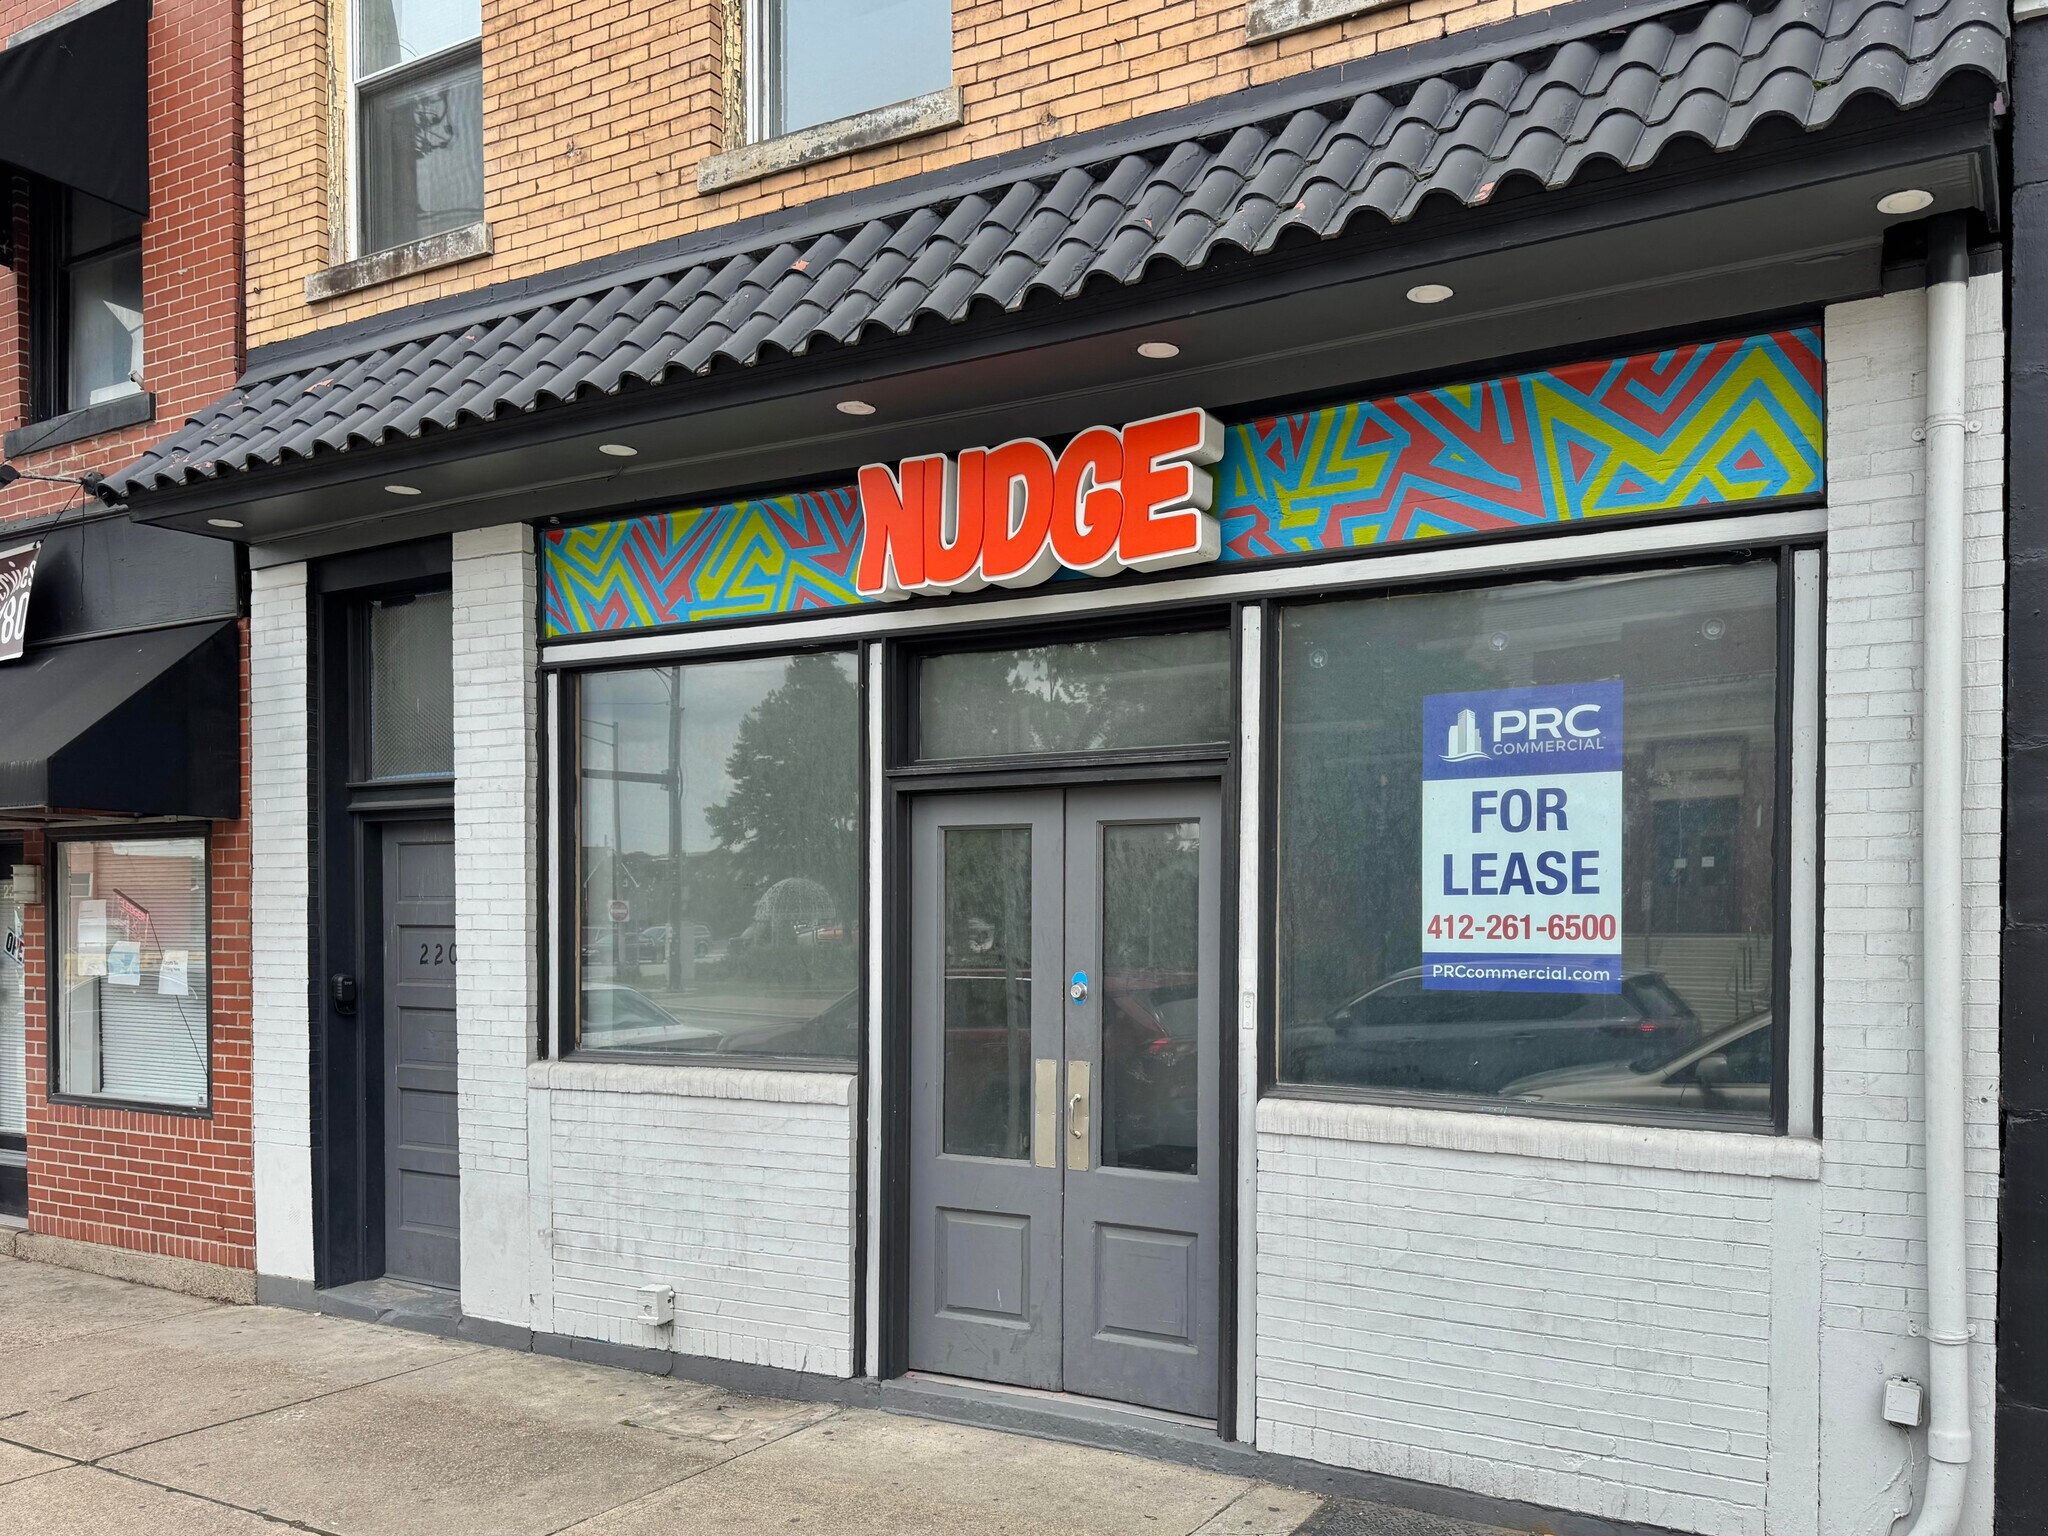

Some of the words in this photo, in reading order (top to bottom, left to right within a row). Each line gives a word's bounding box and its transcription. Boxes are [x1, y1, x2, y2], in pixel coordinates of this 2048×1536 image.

[856, 406, 1208, 600] NUDGE
[1493, 704, 1602, 742] PRC
[1493, 739, 1604, 756] COMMERCIAL
[1471, 787, 1568, 834] FOR
[1443, 850, 1600, 896] LEASE
[1427, 914, 1617, 941] 412-261-6500
[1433, 965, 1610, 982] PRCcommercial.com
